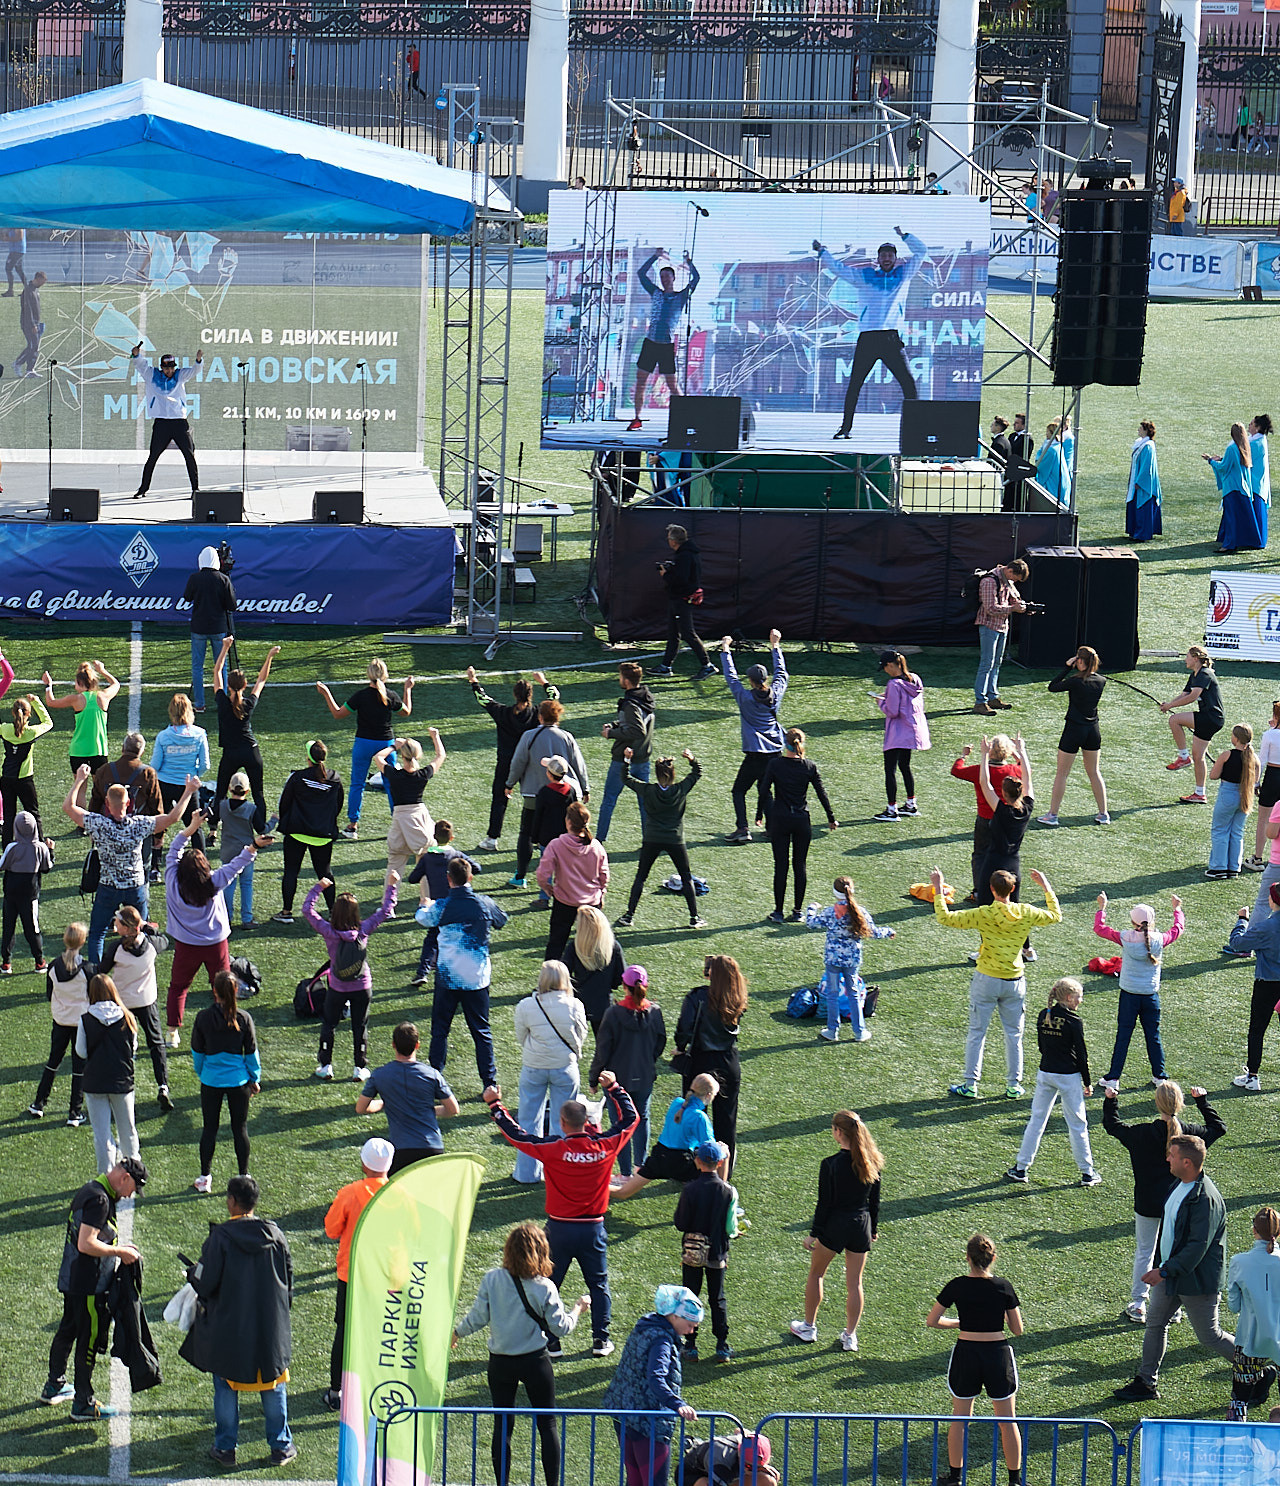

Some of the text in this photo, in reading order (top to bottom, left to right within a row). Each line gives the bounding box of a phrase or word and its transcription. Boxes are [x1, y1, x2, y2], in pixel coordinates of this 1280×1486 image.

[931, 290, 985, 307] СИЛА
[200, 328, 398, 346] СИЛА В ДВИЖЕНИИ!
[103, 394, 201, 421] МИЯ
[222, 406, 251, 419] 21.1
[285, 407, 302, 420] 10
[306, 408, 326, 420] КМ
[330, 408, 341, 420] И
[345, 408, 380, 421] 1609
[384, 408, 396, 421] М
[26, 589, 43, 609] в
[45, 589, 173, 616] движении
[562, 1150, 607, 1163] RUSSIA
[400, 1259, 429, 1370] ИЖЕВСКА
[378, 1288, 403, 1368] ПАРКИ
